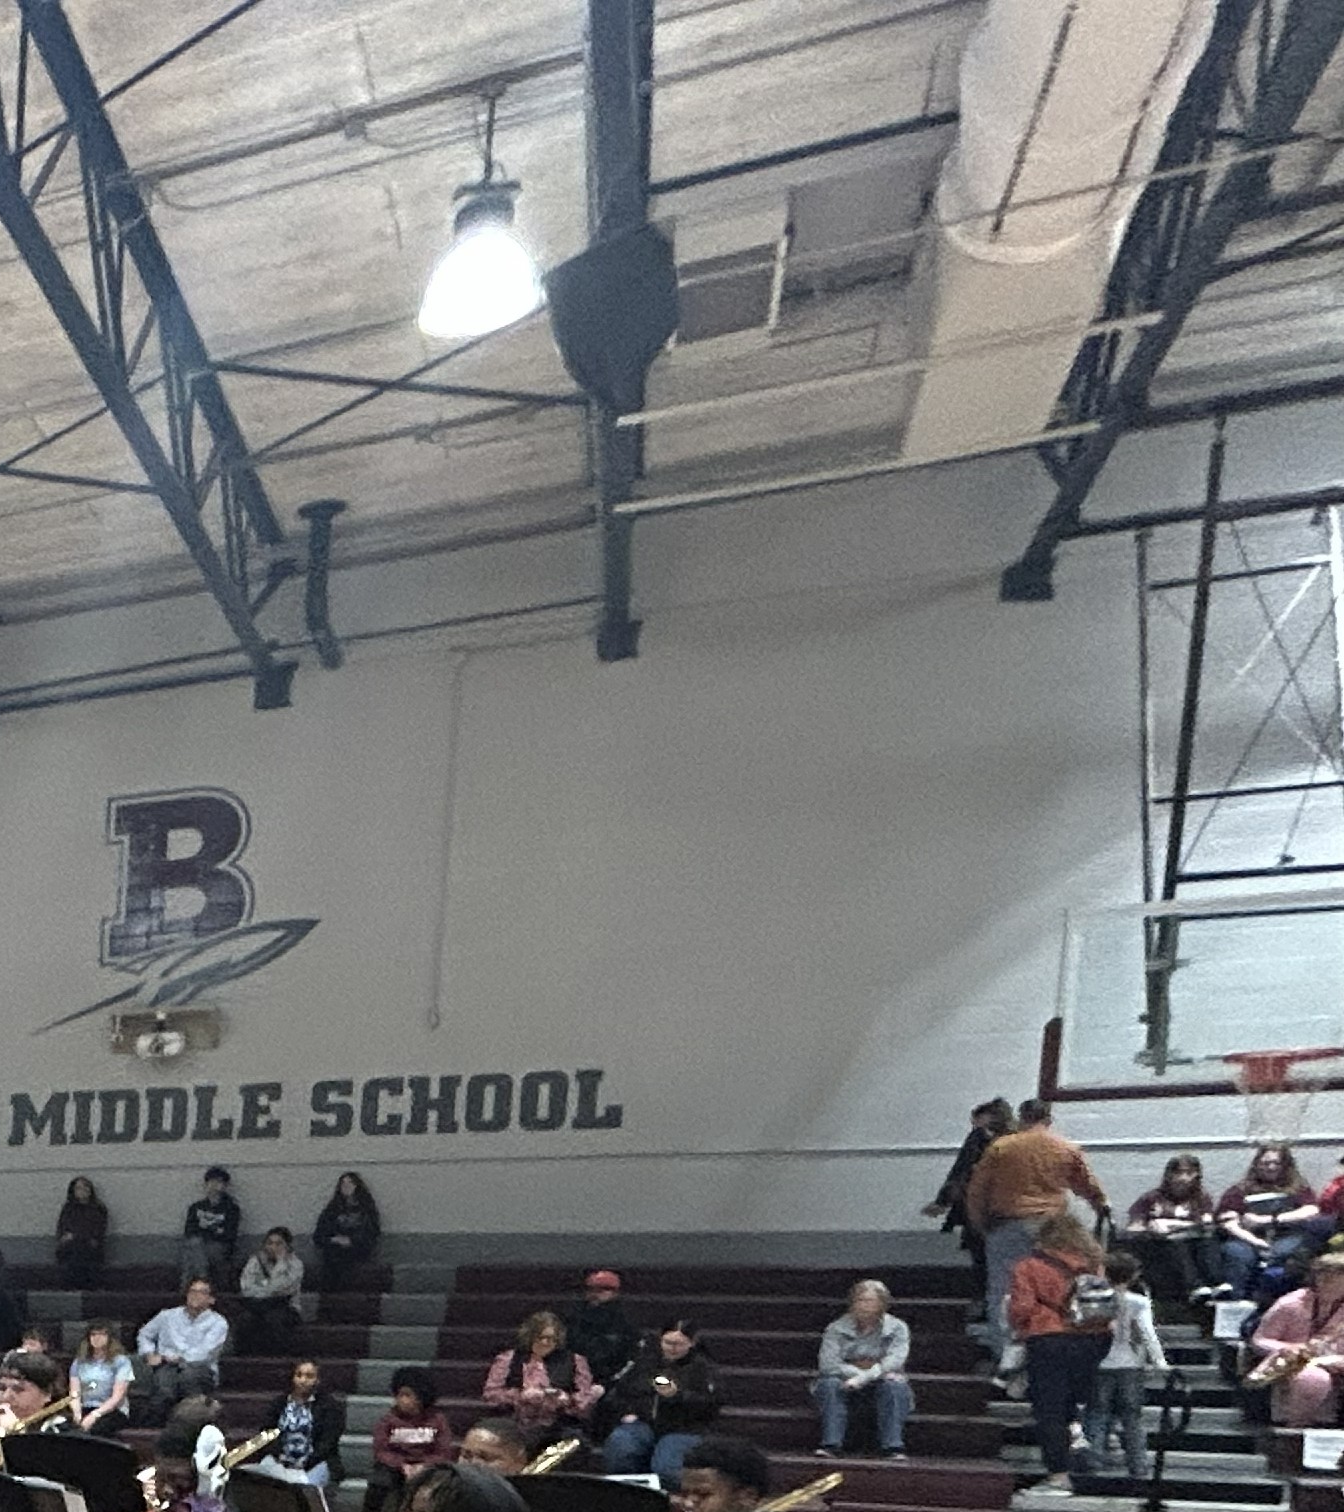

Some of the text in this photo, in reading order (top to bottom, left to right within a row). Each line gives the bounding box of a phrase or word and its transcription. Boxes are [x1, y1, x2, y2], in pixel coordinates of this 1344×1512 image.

[99, 786, 254, 969] B
[7, 1081, 283, 1147] MIDDLE
[310, 1069, 625, 1139] SCHOOL
